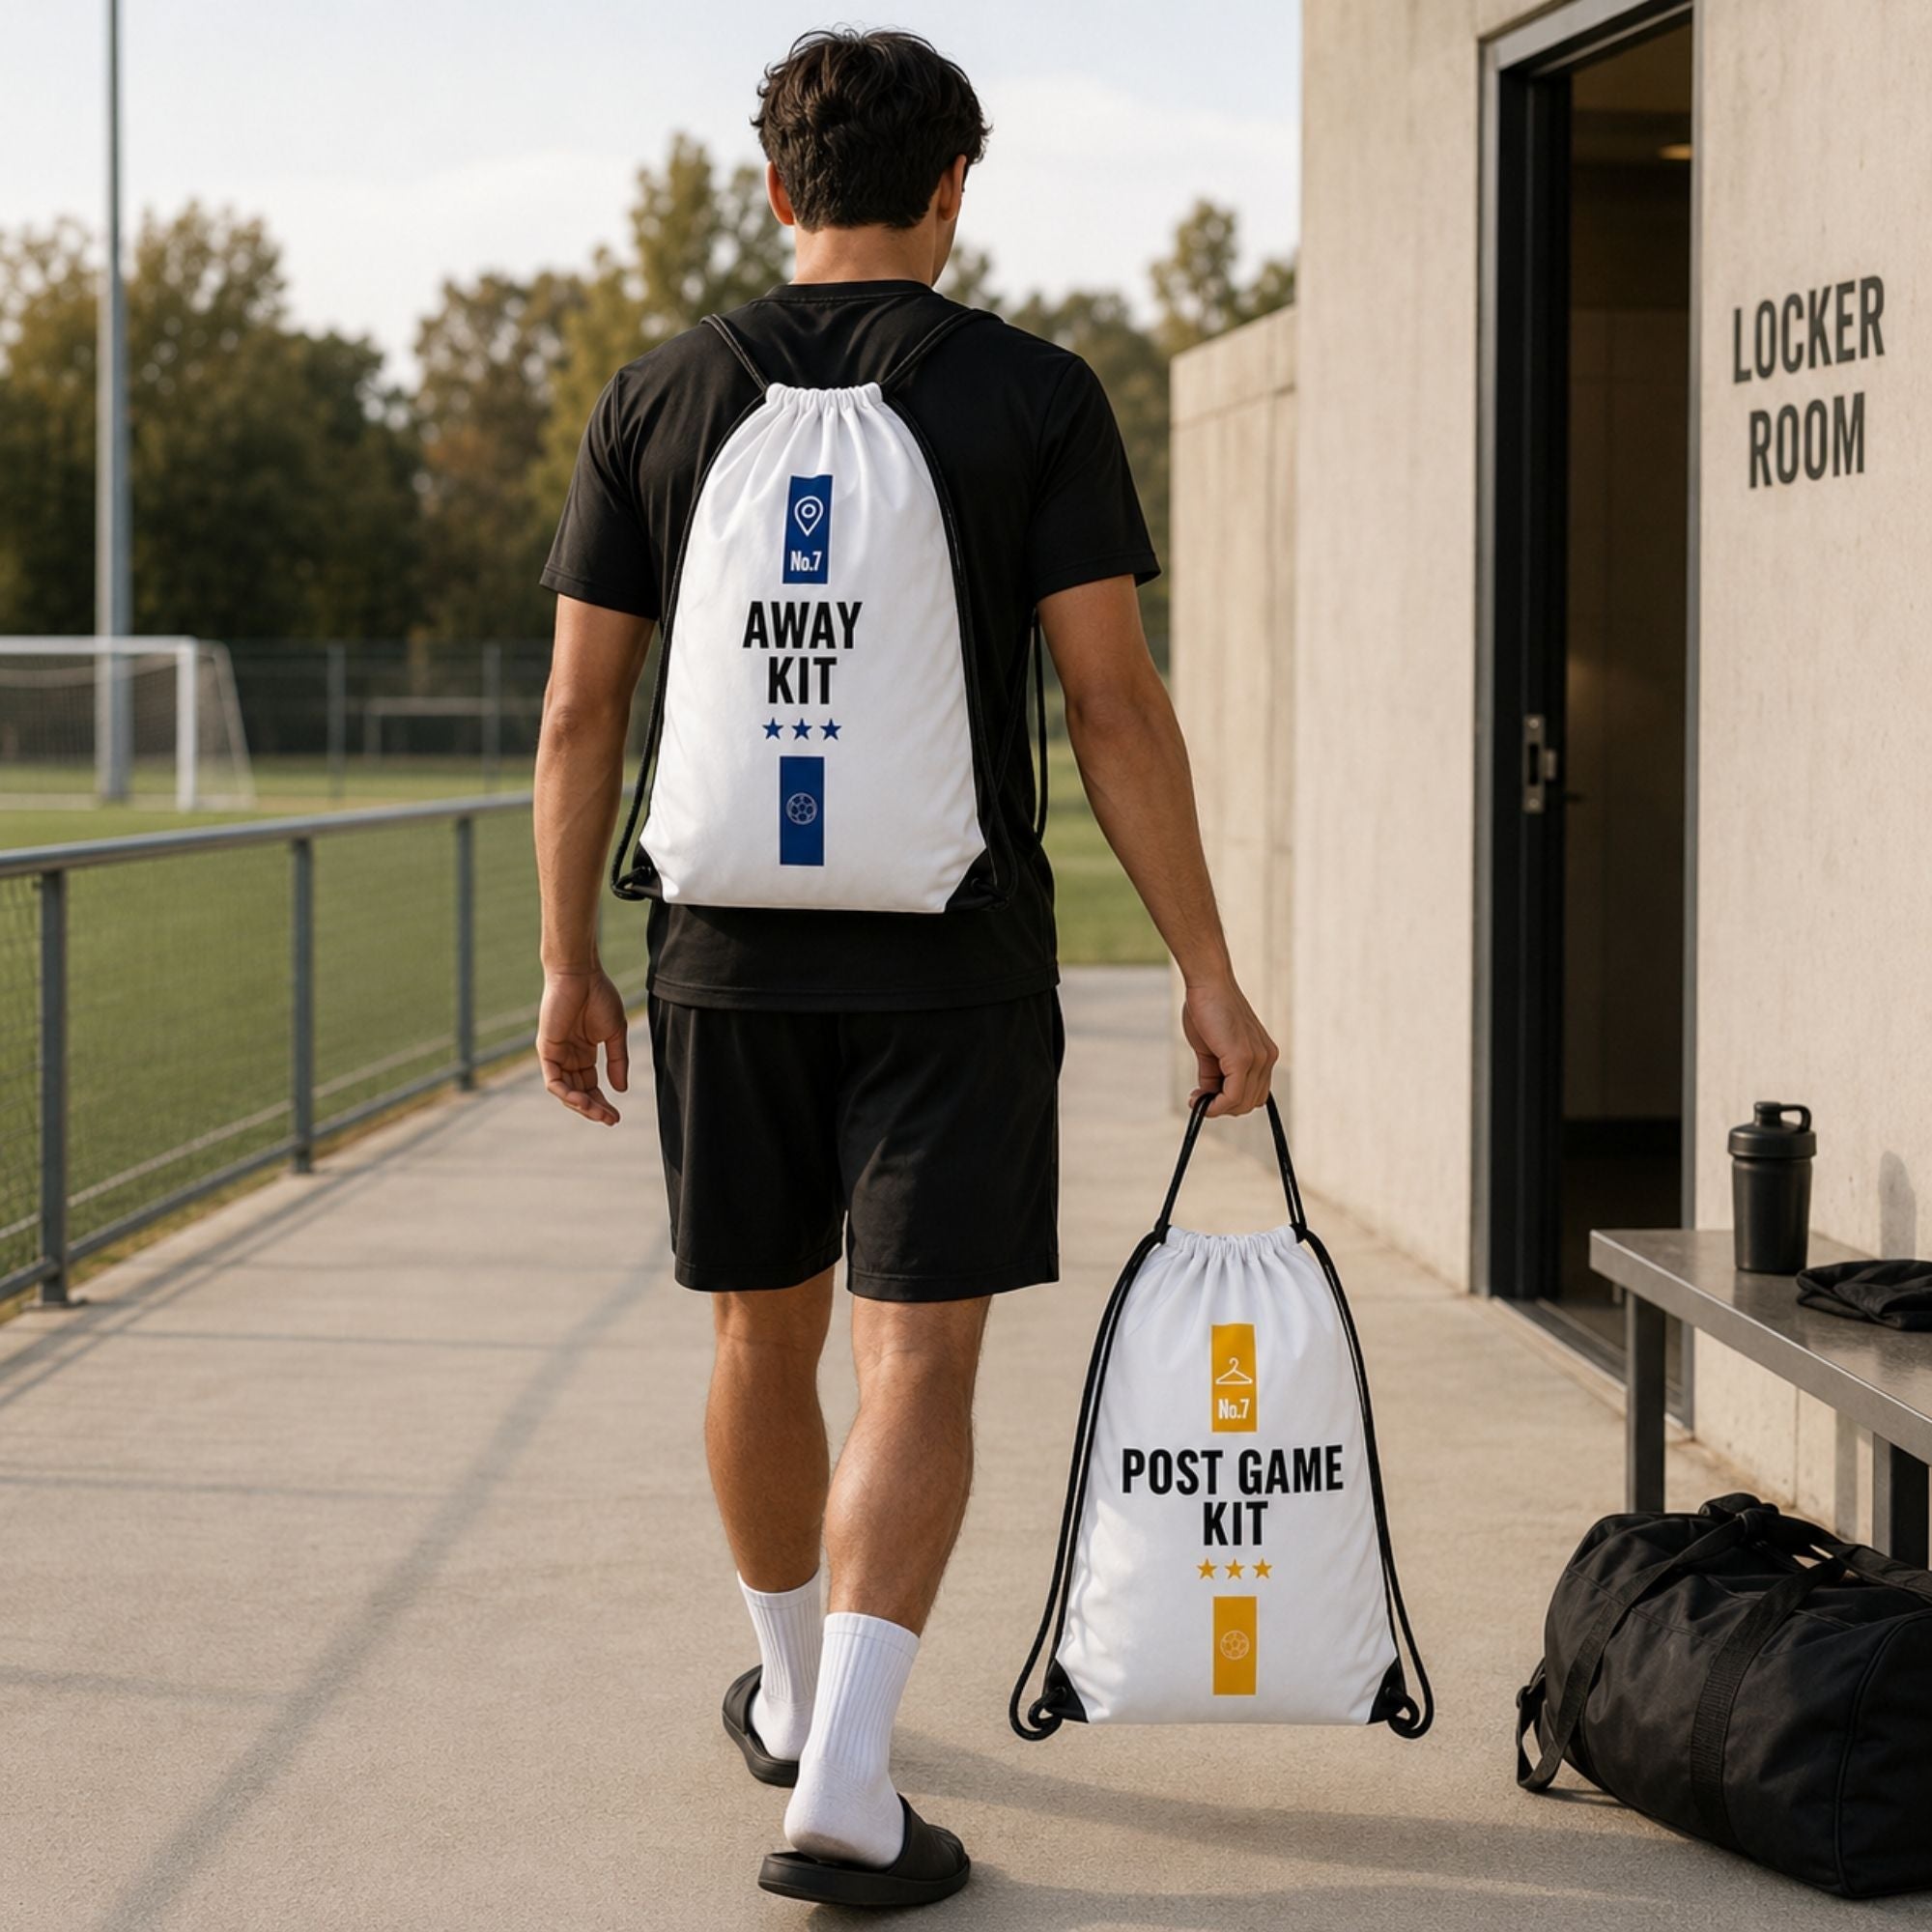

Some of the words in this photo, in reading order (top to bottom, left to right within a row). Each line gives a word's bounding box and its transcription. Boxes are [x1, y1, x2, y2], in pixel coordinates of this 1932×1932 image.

[1733, 276, 1885, 384] LOCKER
[1749, 392, 1864, 489] ROOM
[790, 551, 822, 572] No.7
[743, 601, 863, 649] AWAY
[769, 657, 837, 704] KIT
[1218, 1398, 1250, 1419] No.7
[1123, 1449, 1223, 1495] POST
[1238, 1445, 1343, 1495] GAME
[1204, 1501, 1268, 1546] KIT
